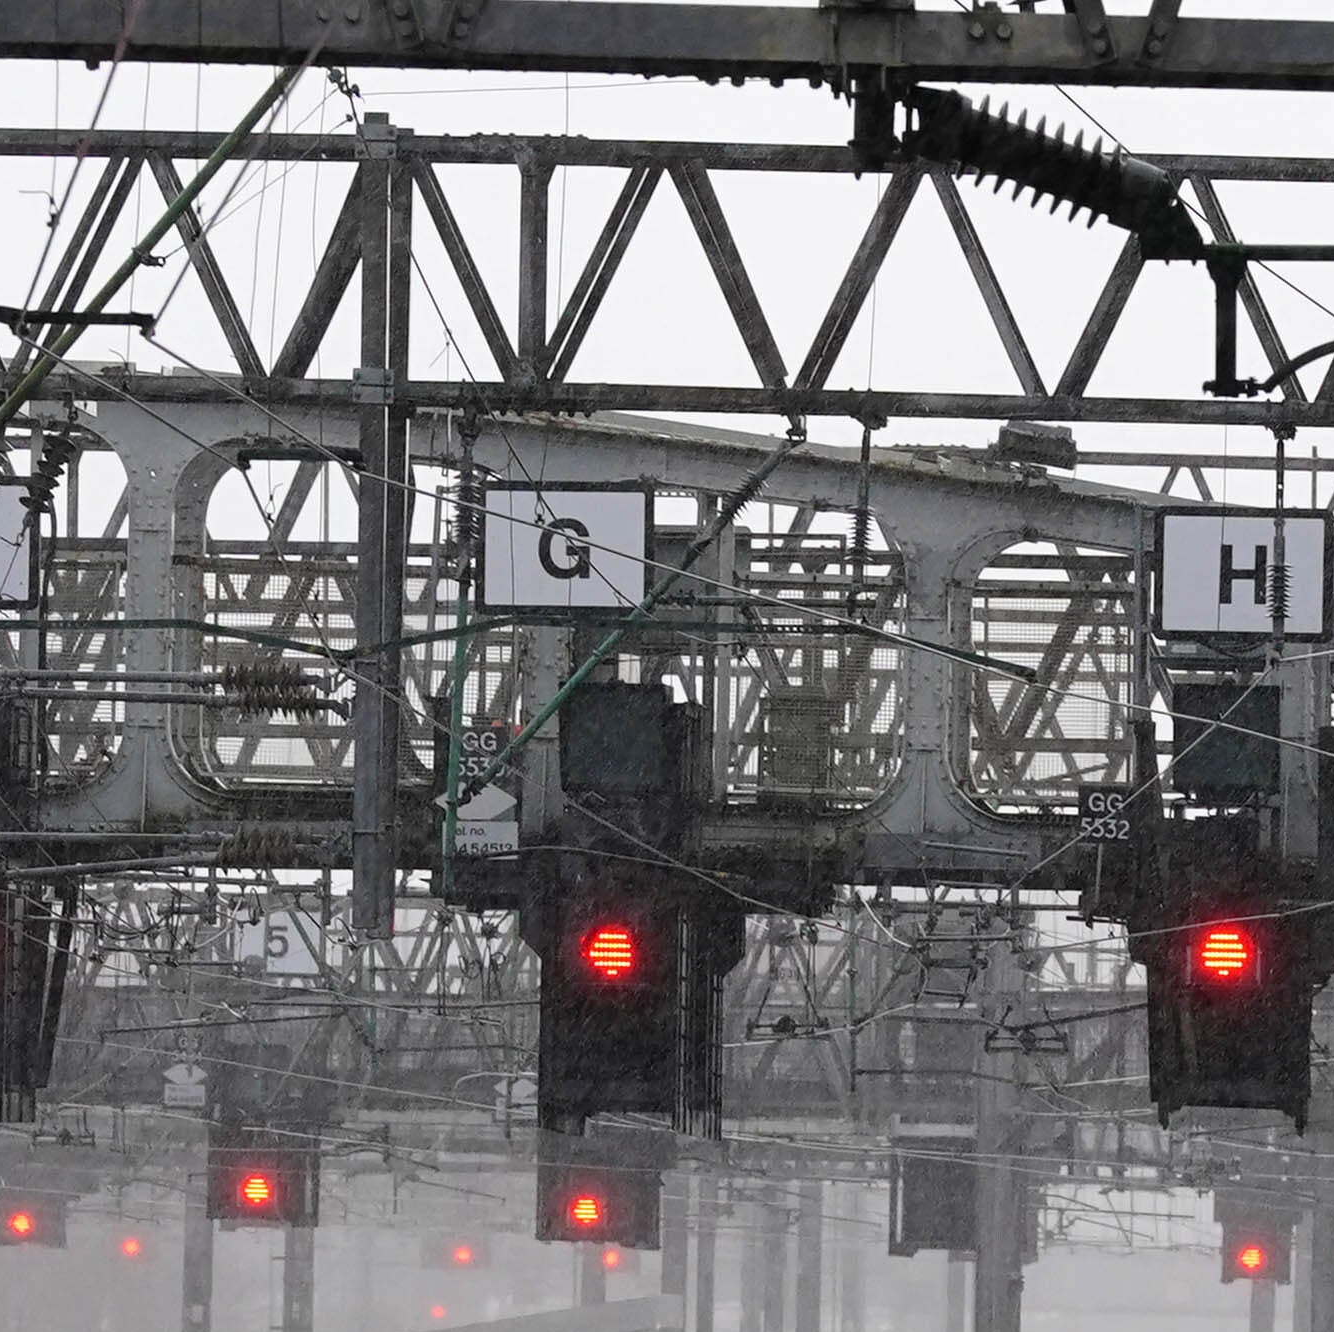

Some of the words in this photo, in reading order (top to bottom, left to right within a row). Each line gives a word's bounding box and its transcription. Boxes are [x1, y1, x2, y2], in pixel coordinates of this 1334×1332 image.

[538, 517, 591, 580] G
[1218, 544, 1268, 604] H
[461, 731, 497, 751] GG
[1088, 792, 1124, 811] GG
[1079, 817, 1130, 840] 5532
